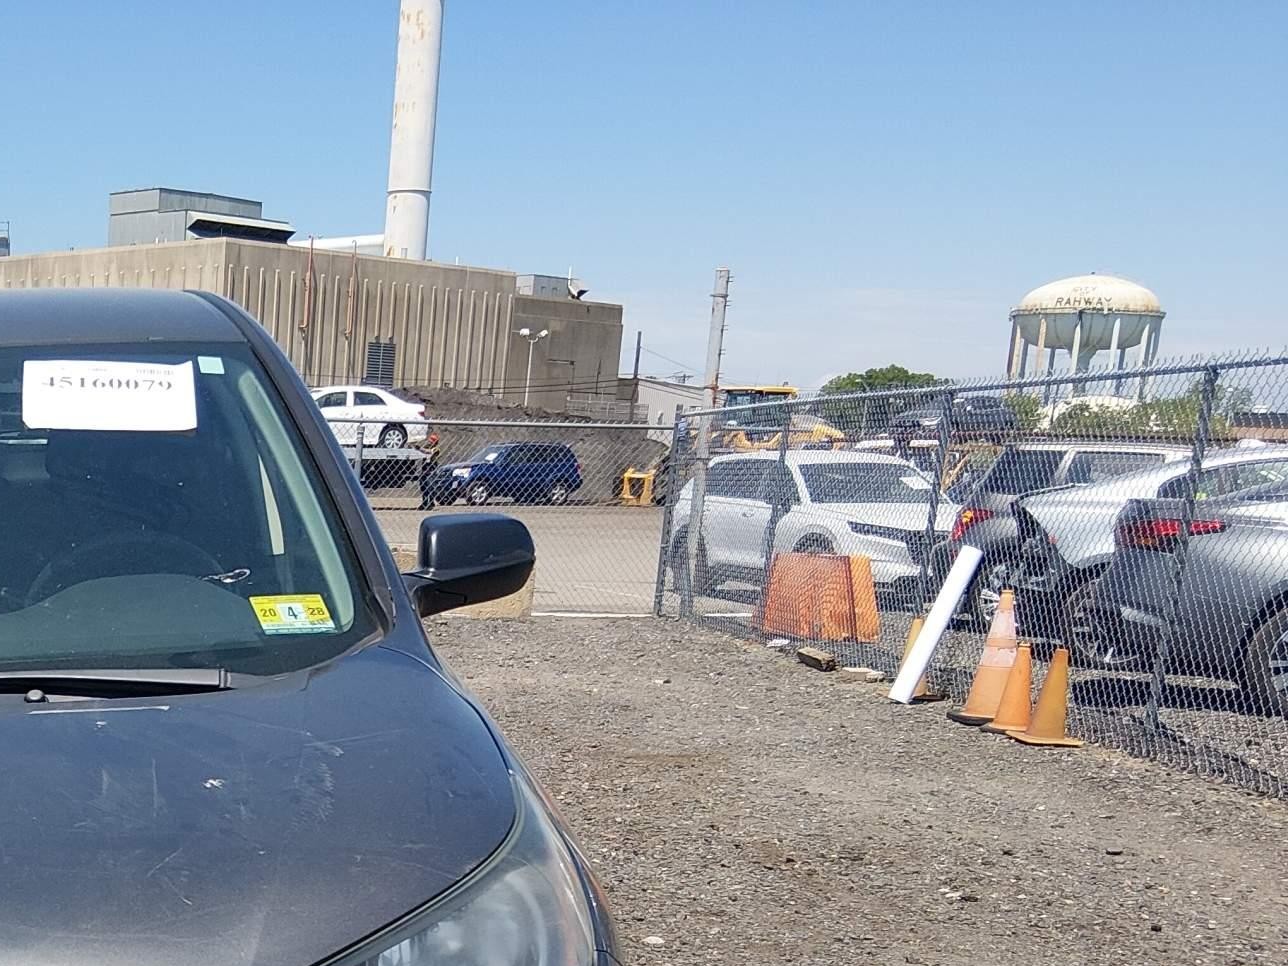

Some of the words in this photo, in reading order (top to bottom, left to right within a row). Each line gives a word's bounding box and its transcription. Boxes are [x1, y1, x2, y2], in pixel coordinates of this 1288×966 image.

[1055, 296, 1113, 306] RAHWAY
[40, 376, 174, 391] 45160079
[260, 608, 278, 618] 20
[287, 606, 299, 620] 4
[307, 607, 325, 616] 28
